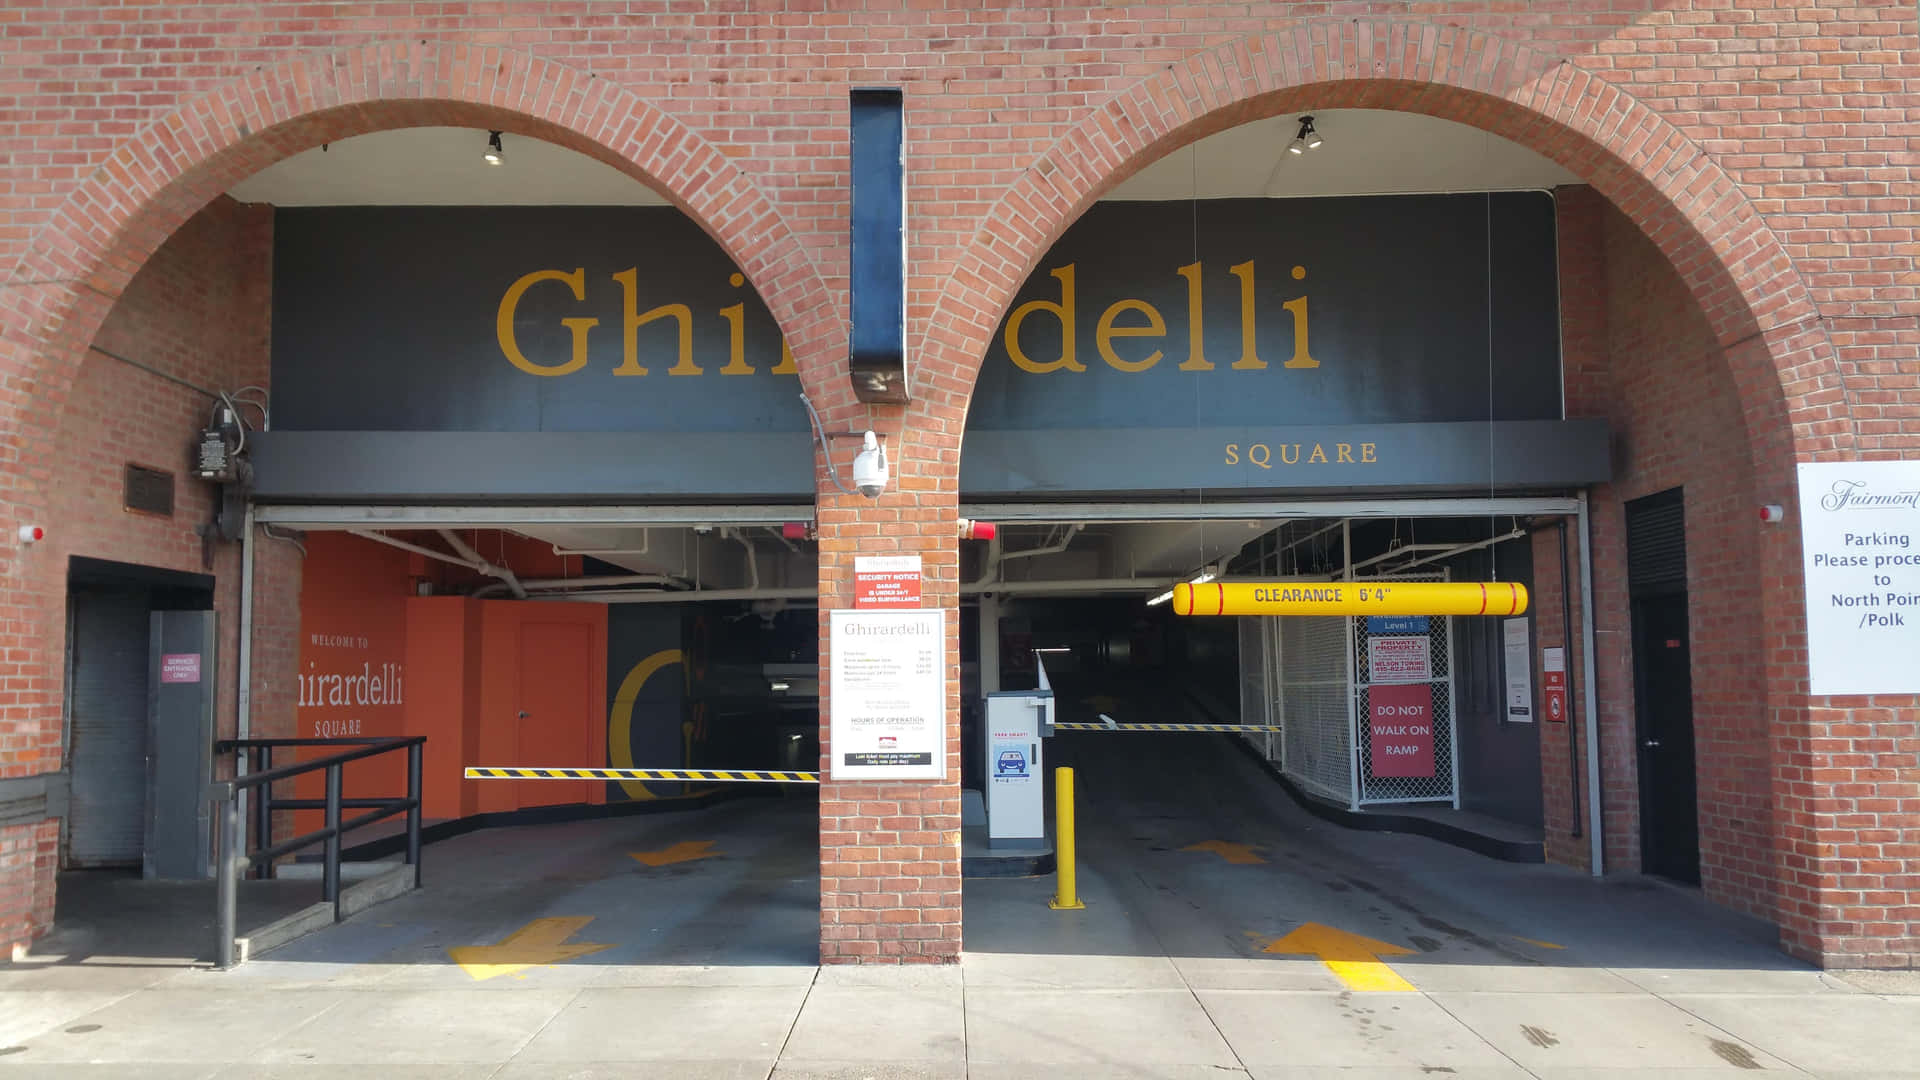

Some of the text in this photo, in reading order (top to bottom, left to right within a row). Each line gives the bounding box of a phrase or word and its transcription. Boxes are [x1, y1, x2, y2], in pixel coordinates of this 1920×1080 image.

[1224, 442, 1377, 469] SQUARE
[1821, 479, 1920, 512] Fairmont
[1844, 531, 1911, 549] Parking
[1814, 553, 1868, 567] Please
[893, 573, 919, 581] NOTICE
[1874, 574, 1891, 586] to
[1254, 588, 1343, 602] CLEARANCE
[1831, 593, 1880, 607] North
[1384, 621, 1407, 630] Level
[1858, 612, 1905, 629] /Polk
[844, 622, 931, 636] Ghirardelli
[311, 634, 369, 649] WELCOME TO
[1377, 705, 1424, 716] DO NOT
[314, 719, 361, 739] SQUARE
[1373, 725, 1430, 736] WALK ON
[1385, 745, 1418, 756] RAMP
